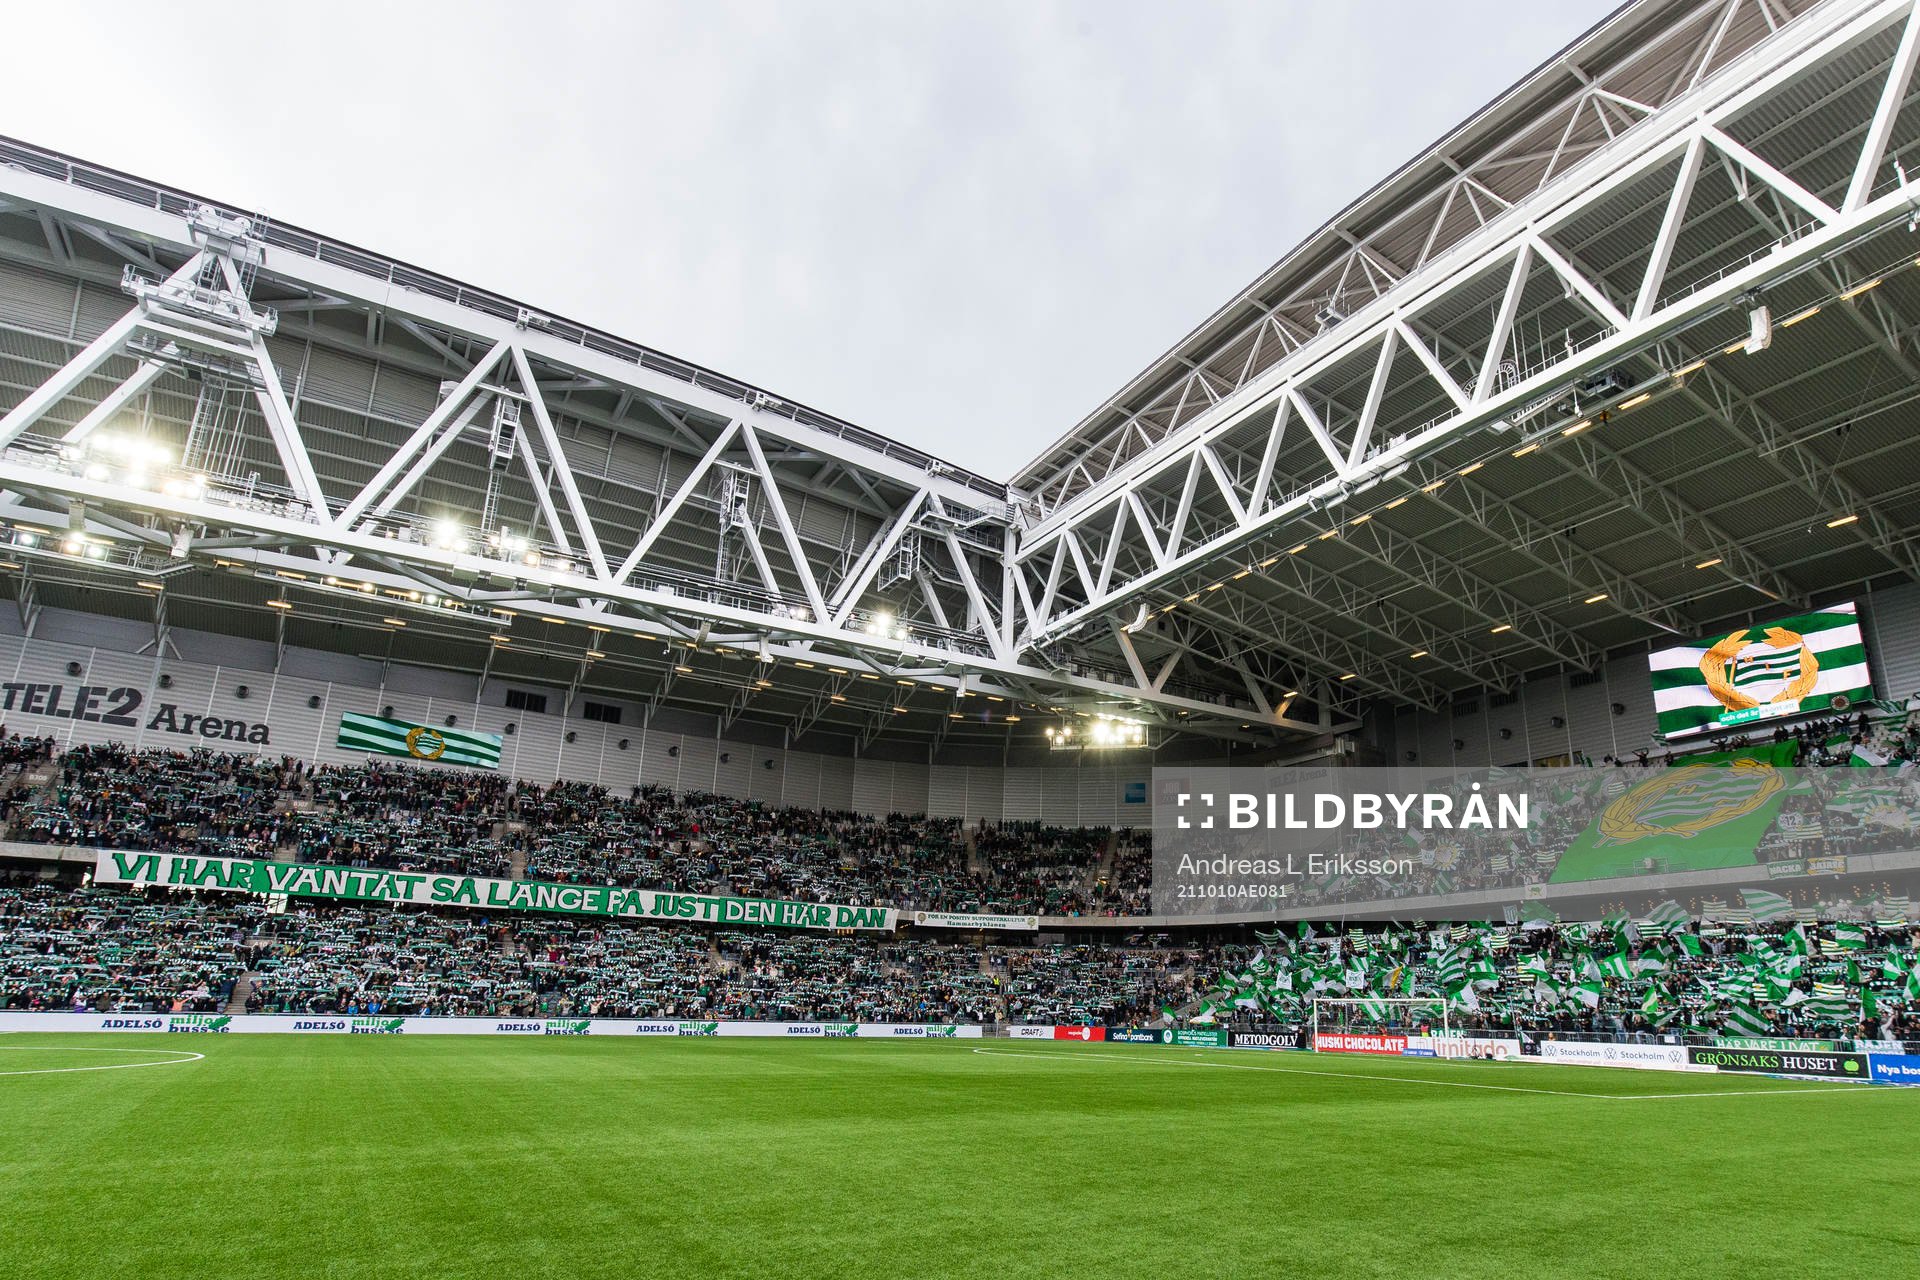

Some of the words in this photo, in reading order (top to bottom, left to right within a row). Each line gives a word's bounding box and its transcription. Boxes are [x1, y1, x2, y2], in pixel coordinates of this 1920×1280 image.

[2, 682, 143, 727] TELE2
[146, 703, 270, 745] Arena
[112, 853, 162, 881] VI
[168, 857, 254, 889] HAR
[266, 865, 426, 900] VÄNTAT
[489, 882, 601, 911] LÄNGE
[650, 891, 720, 920] JUST
[724, 901, 777, 923] DEN
[781, 903, 831, 926] HÄR
[836, 906, 886, 928] DAN
[101, 1018, 163, 1028] ADELSÖ
[293, 1020, 345, 1029] ADELSÖ
[497, 1022, 541, 1031] ADELSÖ
[636, 1024, 674, 1032] ADELSÖ
[1235, 1032, 1298, 1047] METODGOLV
[1316, 1036, 1344, 1049] HUSKI
[1344, 1037, 1405, 1051] CHOCOLATE
[1560, 1048, 1600, 1058] Stockholm
[1620, 1051, 1665, 1060] Stockholm
[1695, 1051, 1779, 1068] GRÖNSAKS
[1782, 1056, 1837, 1071] HUSET
[1877, 1064, 1900, 1076] Nya
